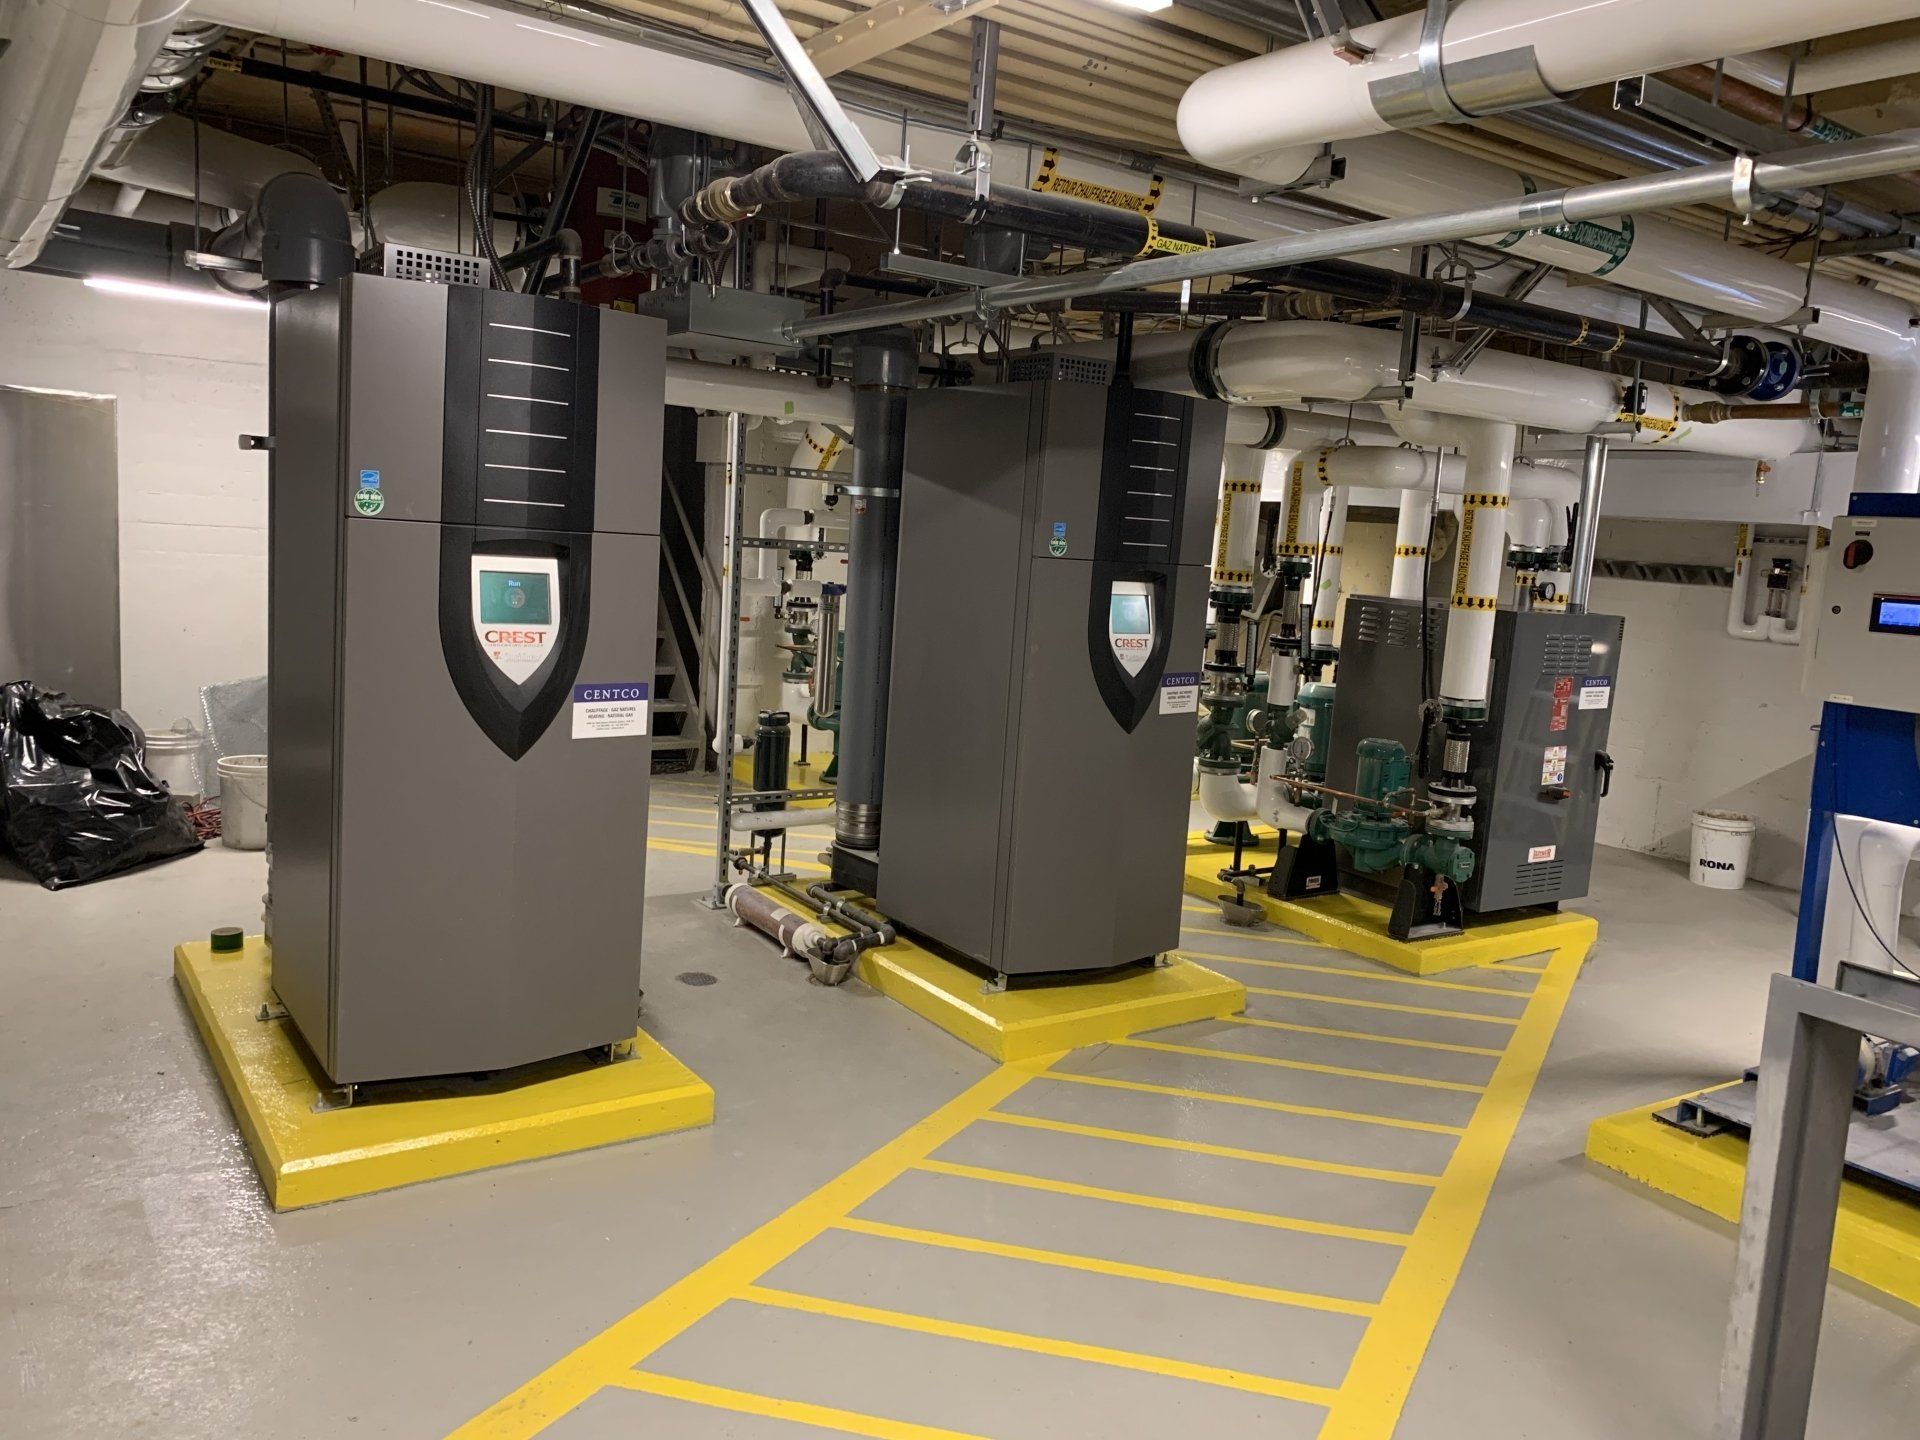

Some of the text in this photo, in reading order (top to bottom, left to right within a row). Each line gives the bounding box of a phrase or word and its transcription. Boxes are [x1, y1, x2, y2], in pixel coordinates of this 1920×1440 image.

[1051, 178, 1145, 211] RETOUR CHAUFFAGE EAU CHAUDE
[1157, 239, 1172, 250] GAZ
[1464, 510, 1474, 530] RETOUR
[1460, 530, 1472, 562] CHAUFFAGE
[1456, 573, 1467, 594] CHAUDE
[484, 630, 547, 644] CREST
[1114, 638, 1150, 648] CREST
[1166, 676, 1195, 686] CENTCO
[584, 688, 640, 700] CENTCO
[1700, 858, 1735, 871] RONA
